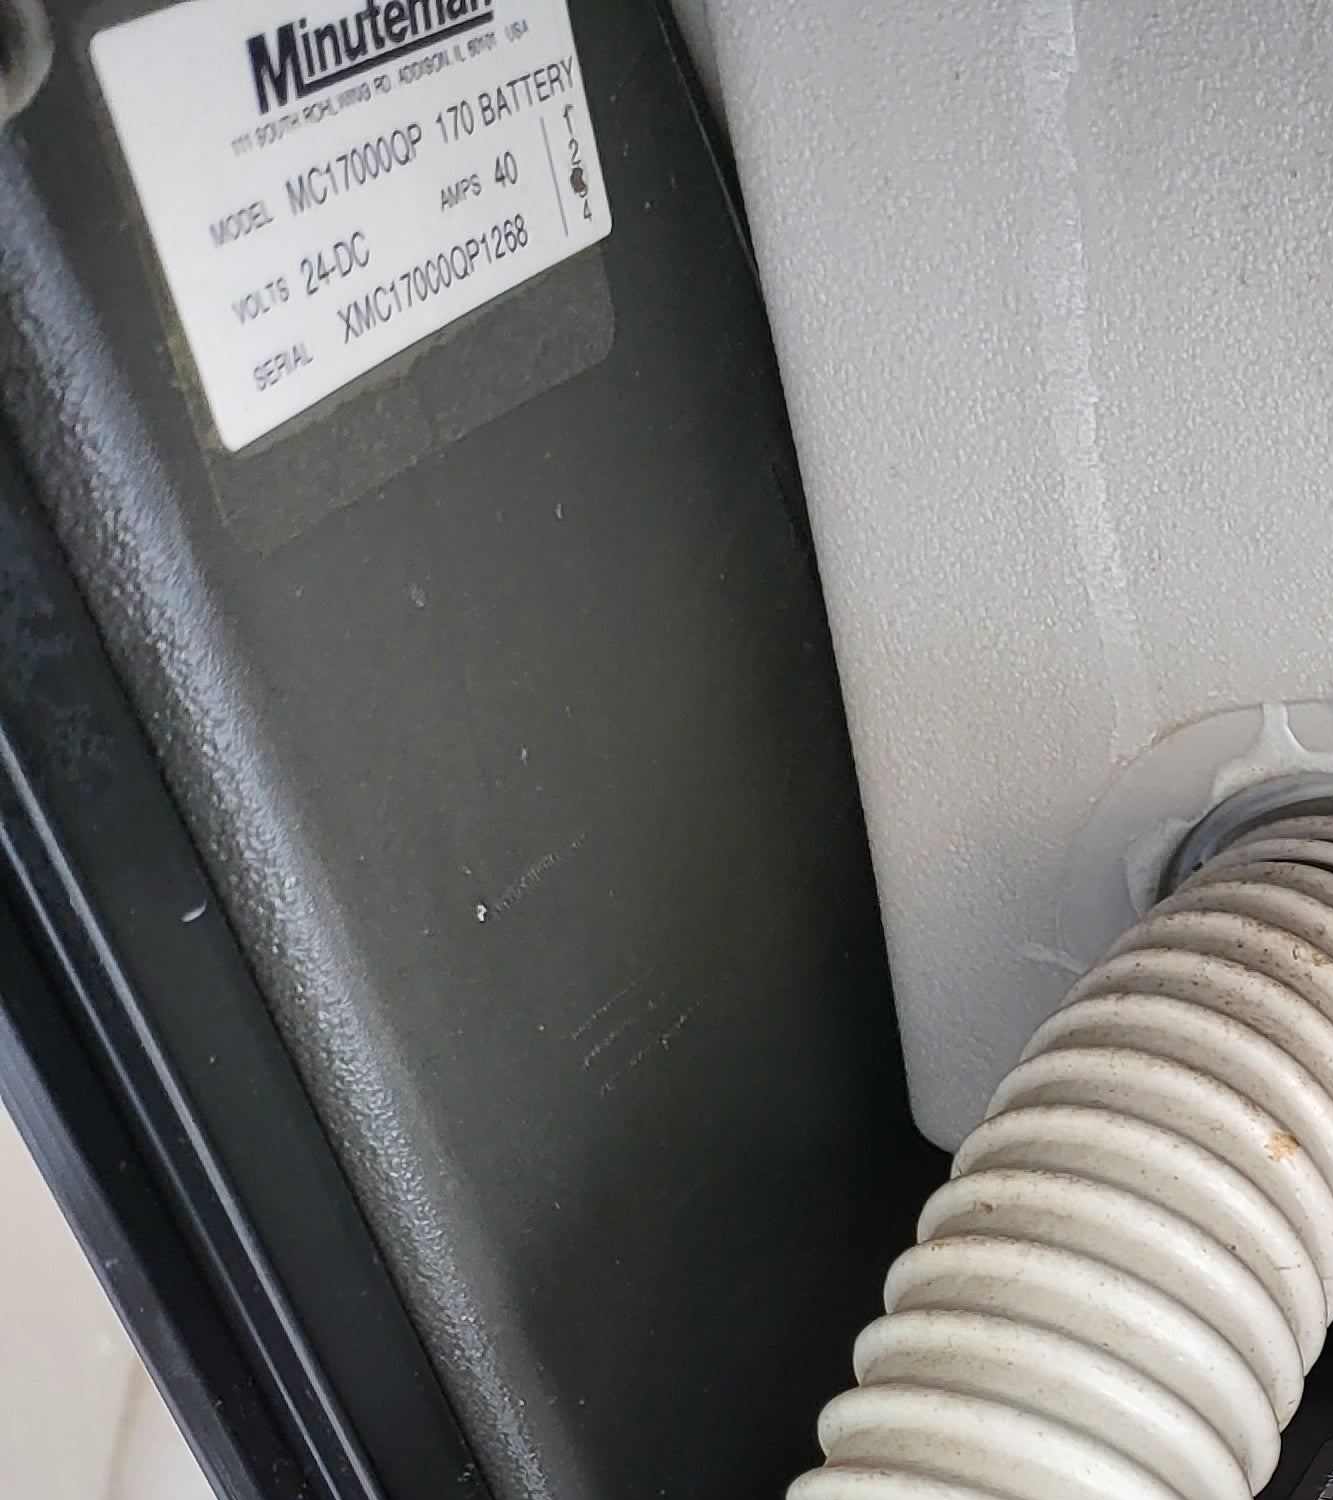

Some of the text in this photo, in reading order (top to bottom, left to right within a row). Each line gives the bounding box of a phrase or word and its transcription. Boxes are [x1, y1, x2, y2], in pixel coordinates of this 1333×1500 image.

[246, 0, 491, 114] Minutema
[210, 57, 574, 247] MODEL MC17000QP 170 BATTERY
[568, 139, 582, 167] 2
[232, 277, 290, 325] VOLTS
[300, 231, 370, 296] 24-DC
[440, 173, 481, 213] AMPS
[494, 151, 518, 188] 40
[254, 342, 313, 391] SERIAL
